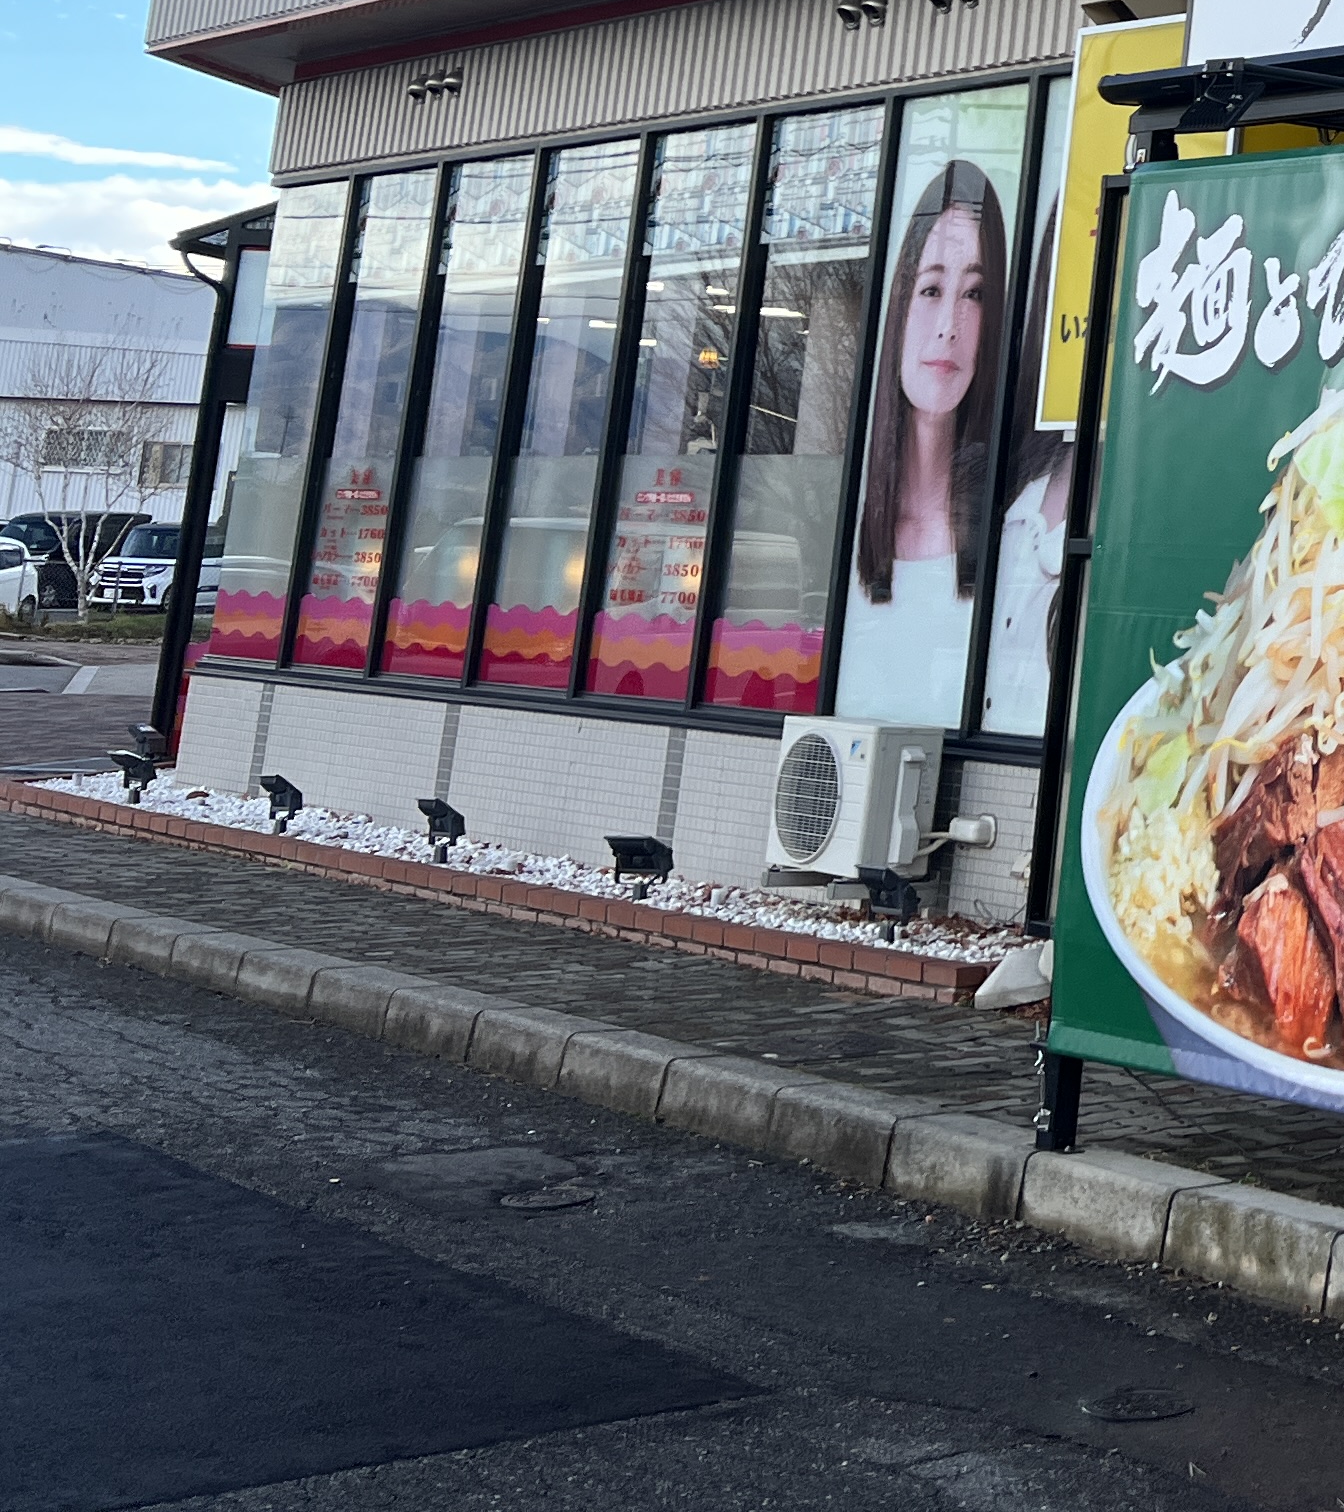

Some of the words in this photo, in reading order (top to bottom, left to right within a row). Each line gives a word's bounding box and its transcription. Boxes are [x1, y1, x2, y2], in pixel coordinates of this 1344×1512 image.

[353, 551, 382, 564] 3850
[663, 563, 700, 578] 3850
[660, 591, 697, 605] 7700
